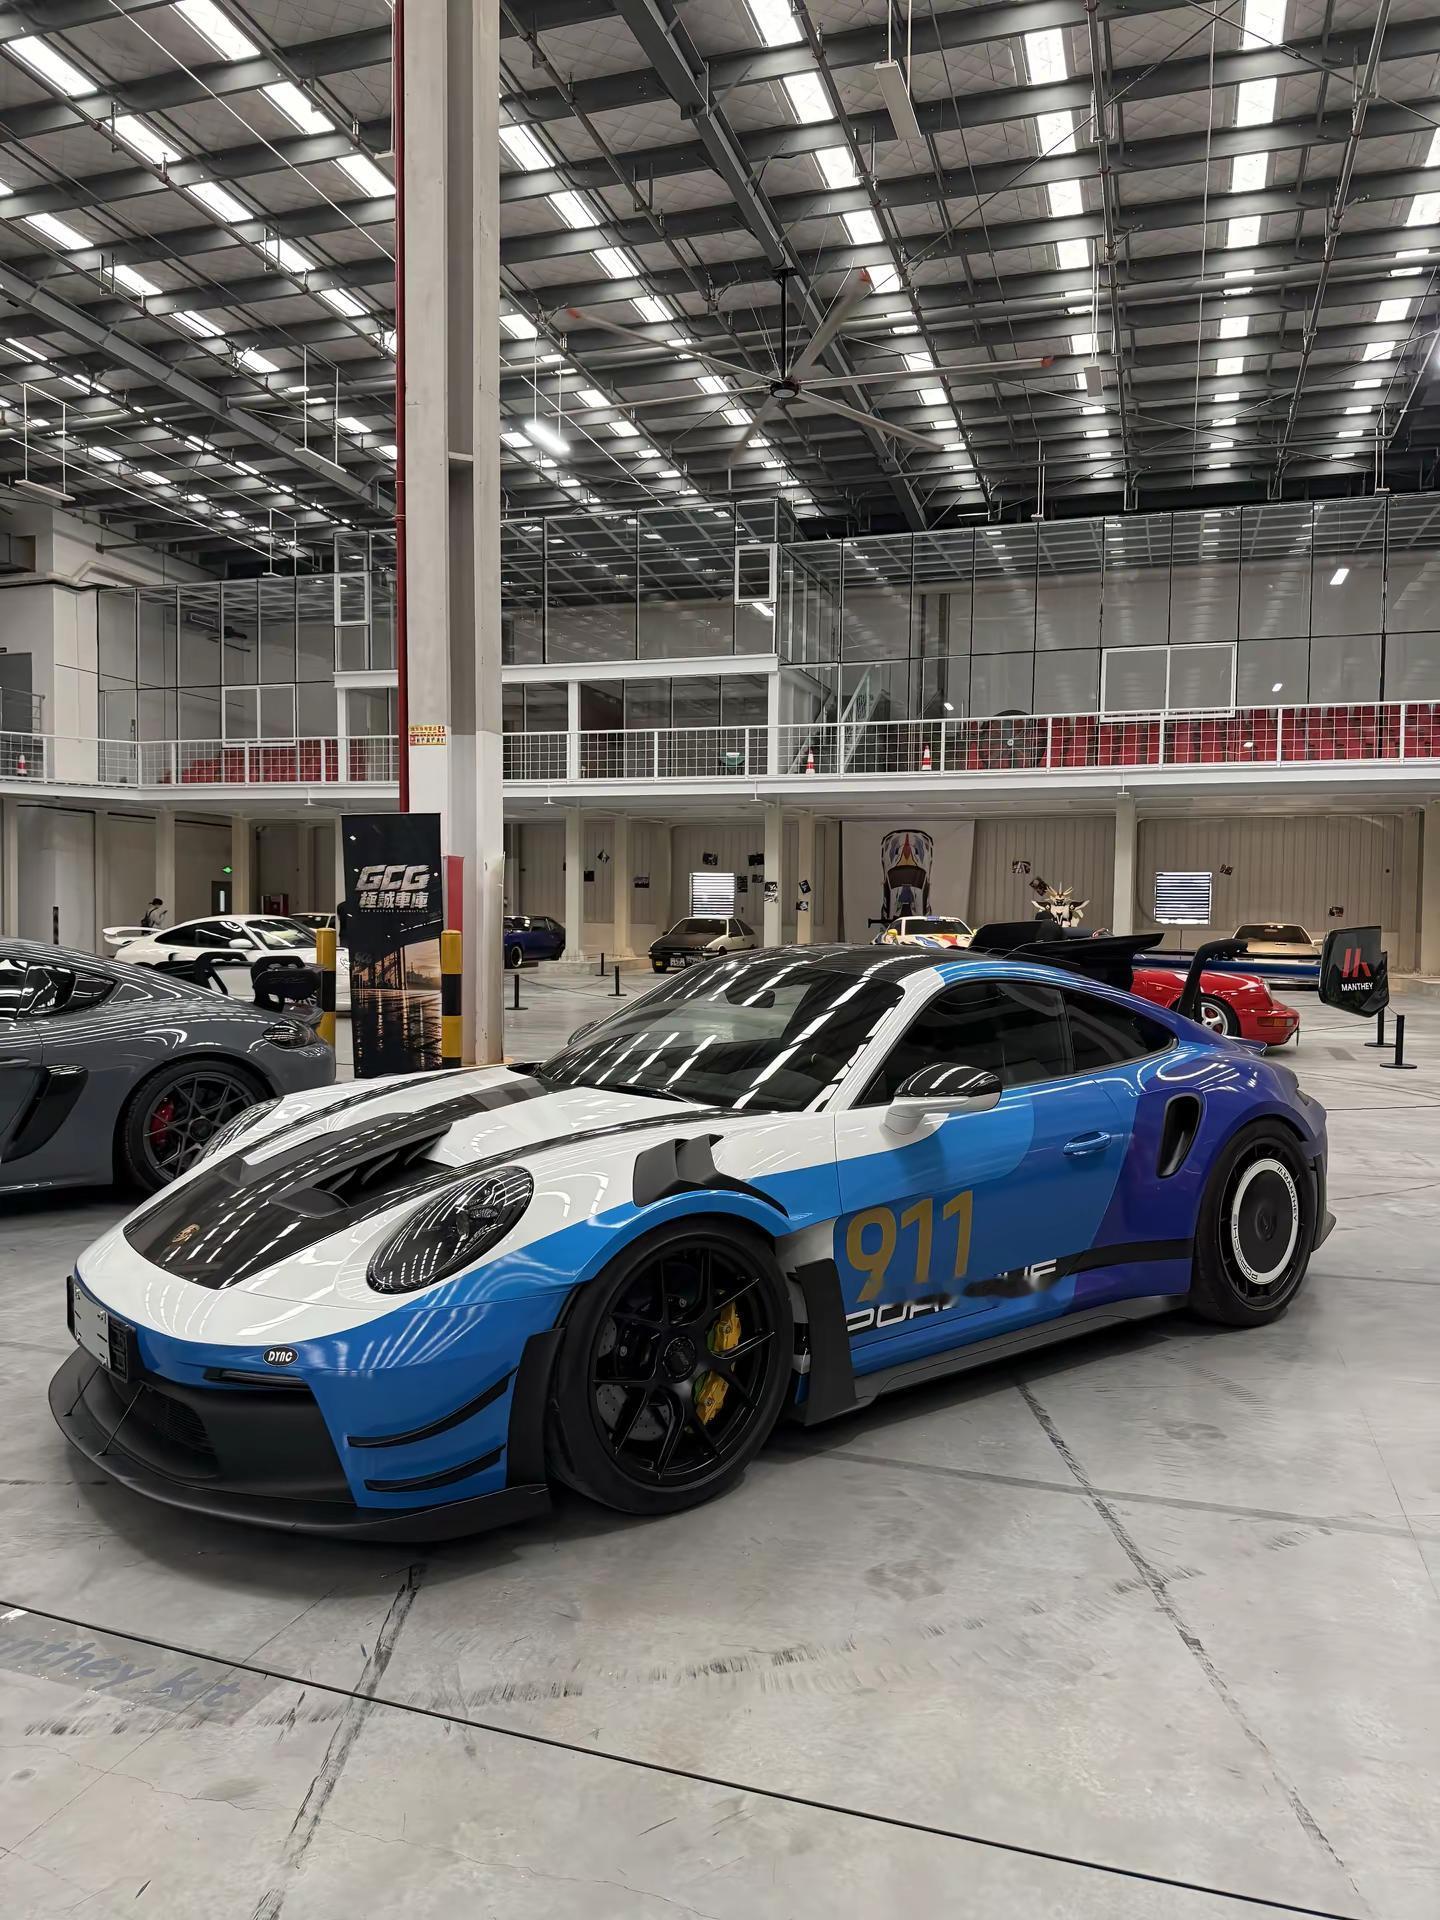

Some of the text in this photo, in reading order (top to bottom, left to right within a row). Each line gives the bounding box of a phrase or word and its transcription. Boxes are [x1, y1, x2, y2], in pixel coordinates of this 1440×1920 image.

[355, 864, 431, 891] GCG
[359, 891, 429, 909] 極誠車庫
[1341, 982, 1374, 992] MANTHEY
[846, 1190, 973, 1303] 911
